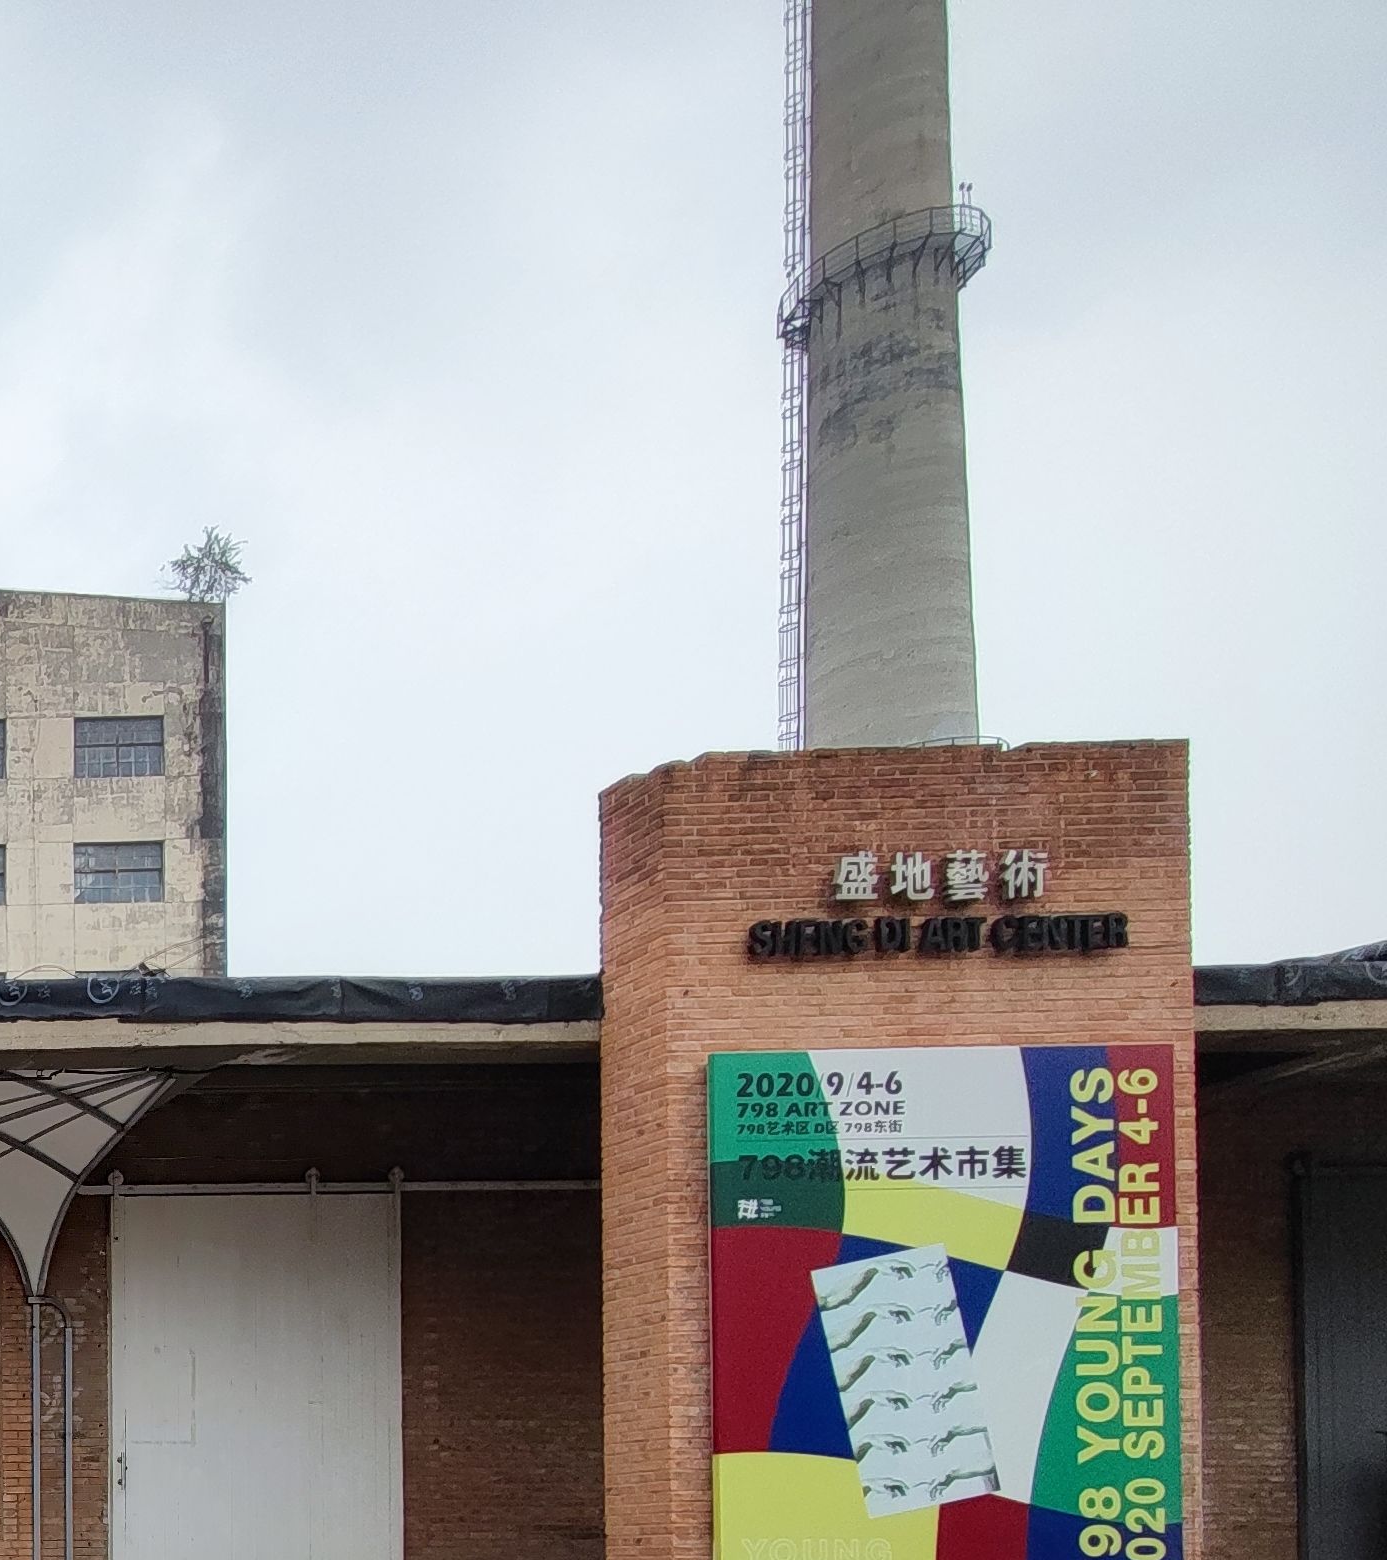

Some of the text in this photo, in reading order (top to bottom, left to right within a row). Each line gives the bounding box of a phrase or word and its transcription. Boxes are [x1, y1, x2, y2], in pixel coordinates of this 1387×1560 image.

[835, 849, 1049, 901] 盛地藝術
[748, 912, 1129, 955] SHENG DI ART CENTER
[736, 1070, 903, 1098] 2020/9/4-6
[1117, 1068, 1159, 1145] 4-6
[736, 1100, 906, 1118] 798 ART ZONE
[736, 1119, 903, 1135] 798艺术区 D区 798东街
[738, 1145, 1027, 1183] 798潮流艺术市集
[1069, 1067, 1116, 1224] DAYS
[1118, 1162, 1165, 1460] SEPTEMBER
[1072, 1249, 1121, 1465] YOUNG
